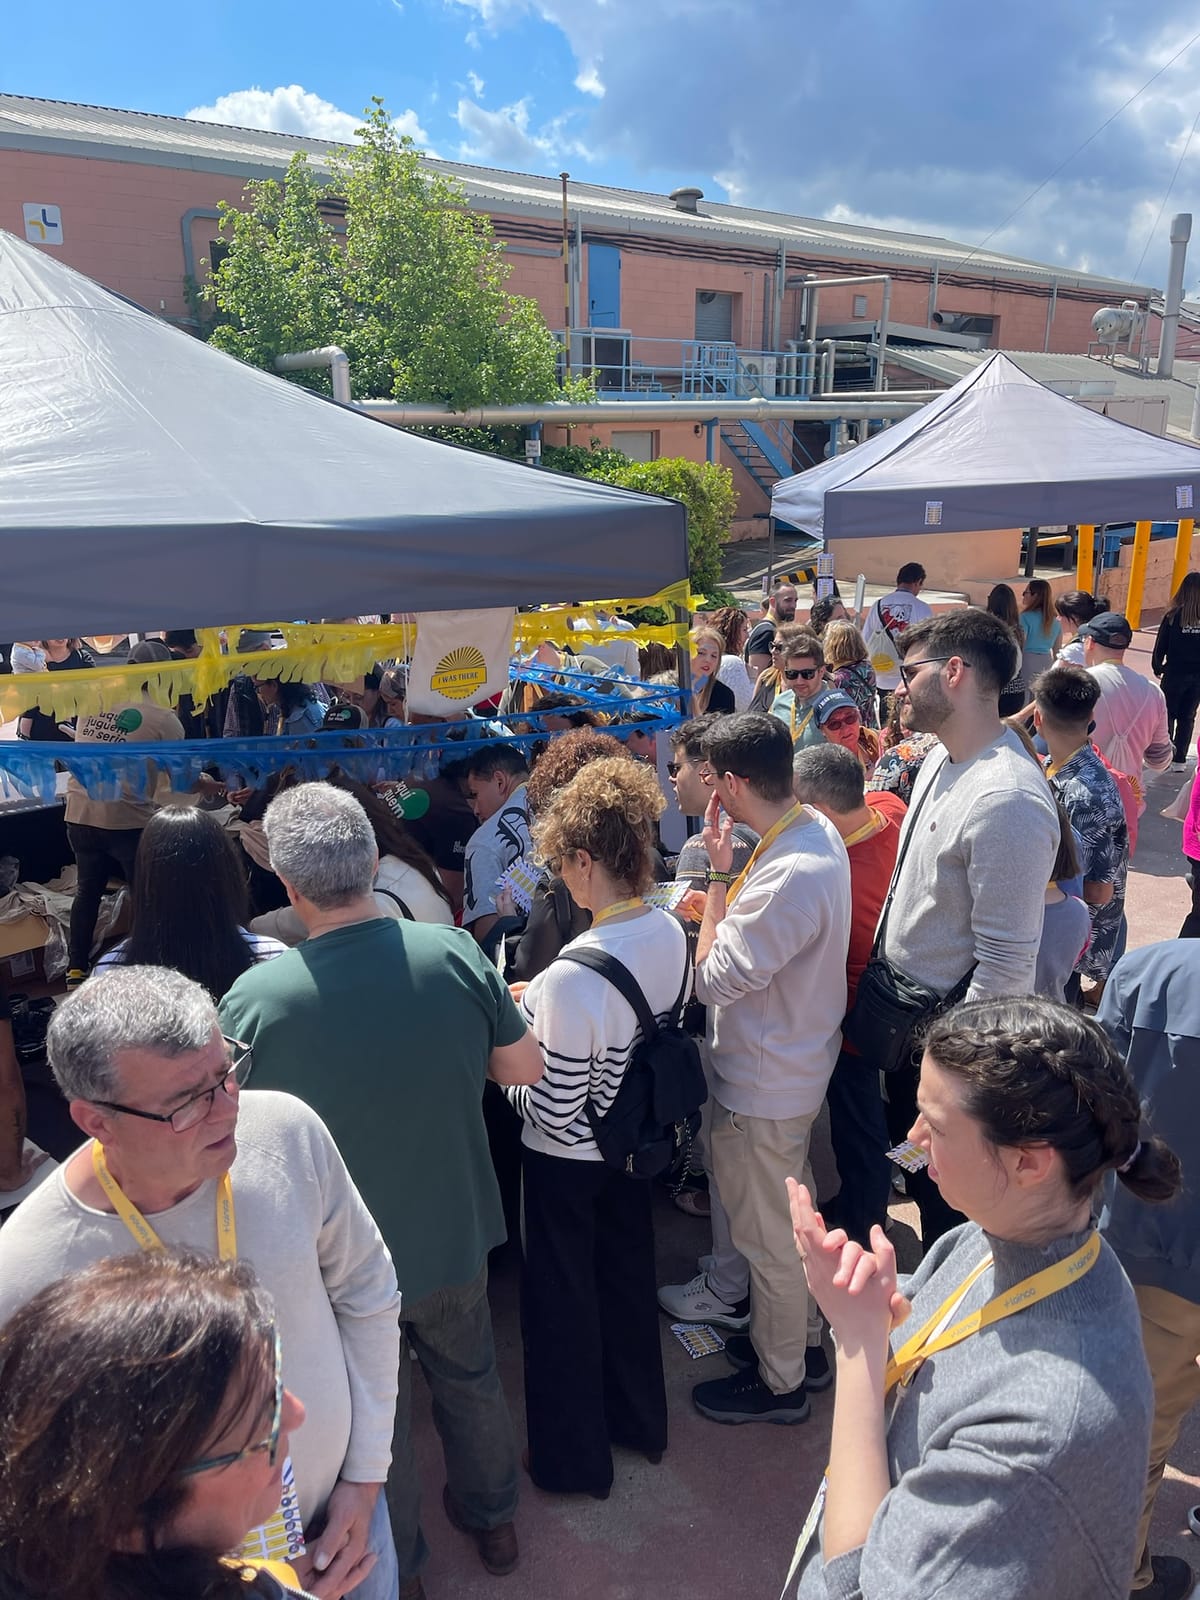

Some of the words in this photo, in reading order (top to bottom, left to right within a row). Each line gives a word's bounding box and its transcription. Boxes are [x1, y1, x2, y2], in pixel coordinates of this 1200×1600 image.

[442, 674, 457, 683] WAS
[458, 671, 479, 681] THERE
[83, 728, 95, 736] en
[86, 716, 129, 736] juguem
